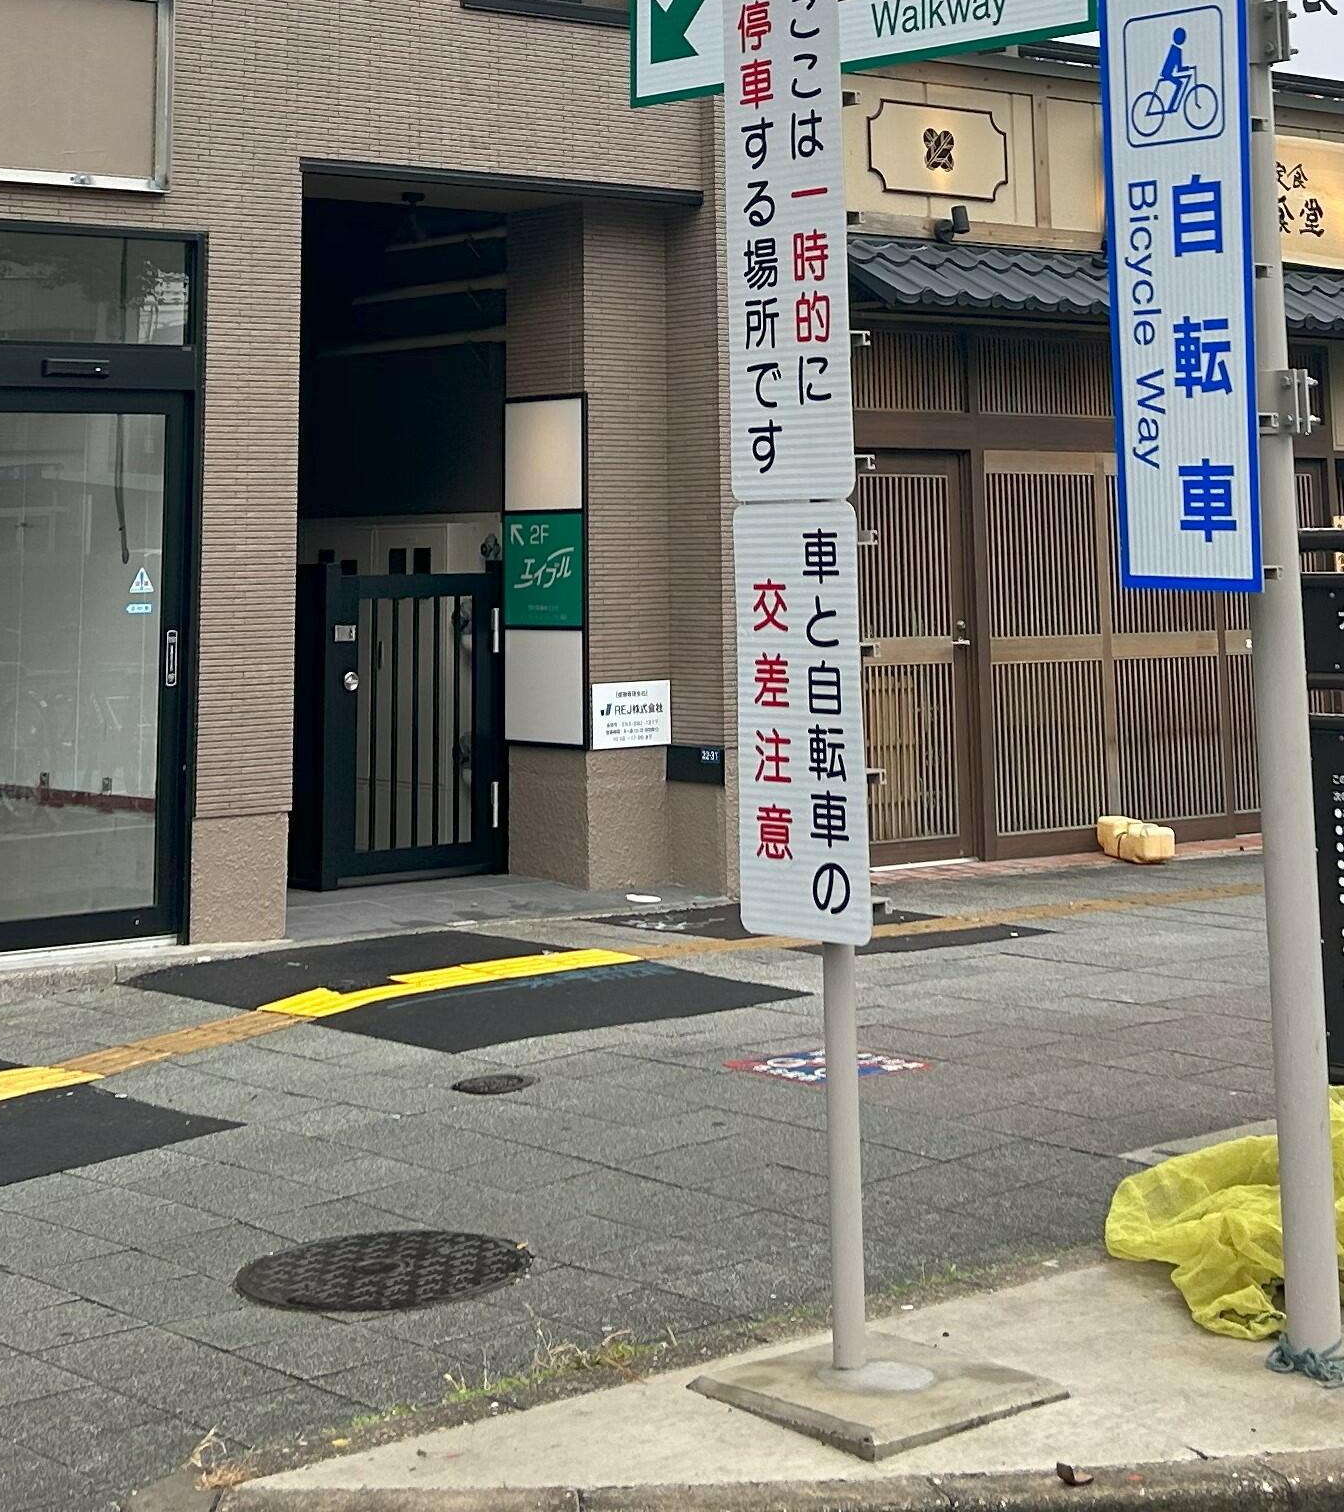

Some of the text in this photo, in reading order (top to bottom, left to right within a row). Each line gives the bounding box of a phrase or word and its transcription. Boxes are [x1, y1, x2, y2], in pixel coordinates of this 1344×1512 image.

[736, 0, 783, 474] 停車する場所です
[1124, 178, 1168, 471] Bicycle Way
[1171, 173, 1237, 543] 自転車
[514, 547, 574, 589] エイブル
[530, 524, 549, 545] 2F
[752, 578, 794, 861] 交差注意
[802, 527, 851, 915] 車と自転車の
